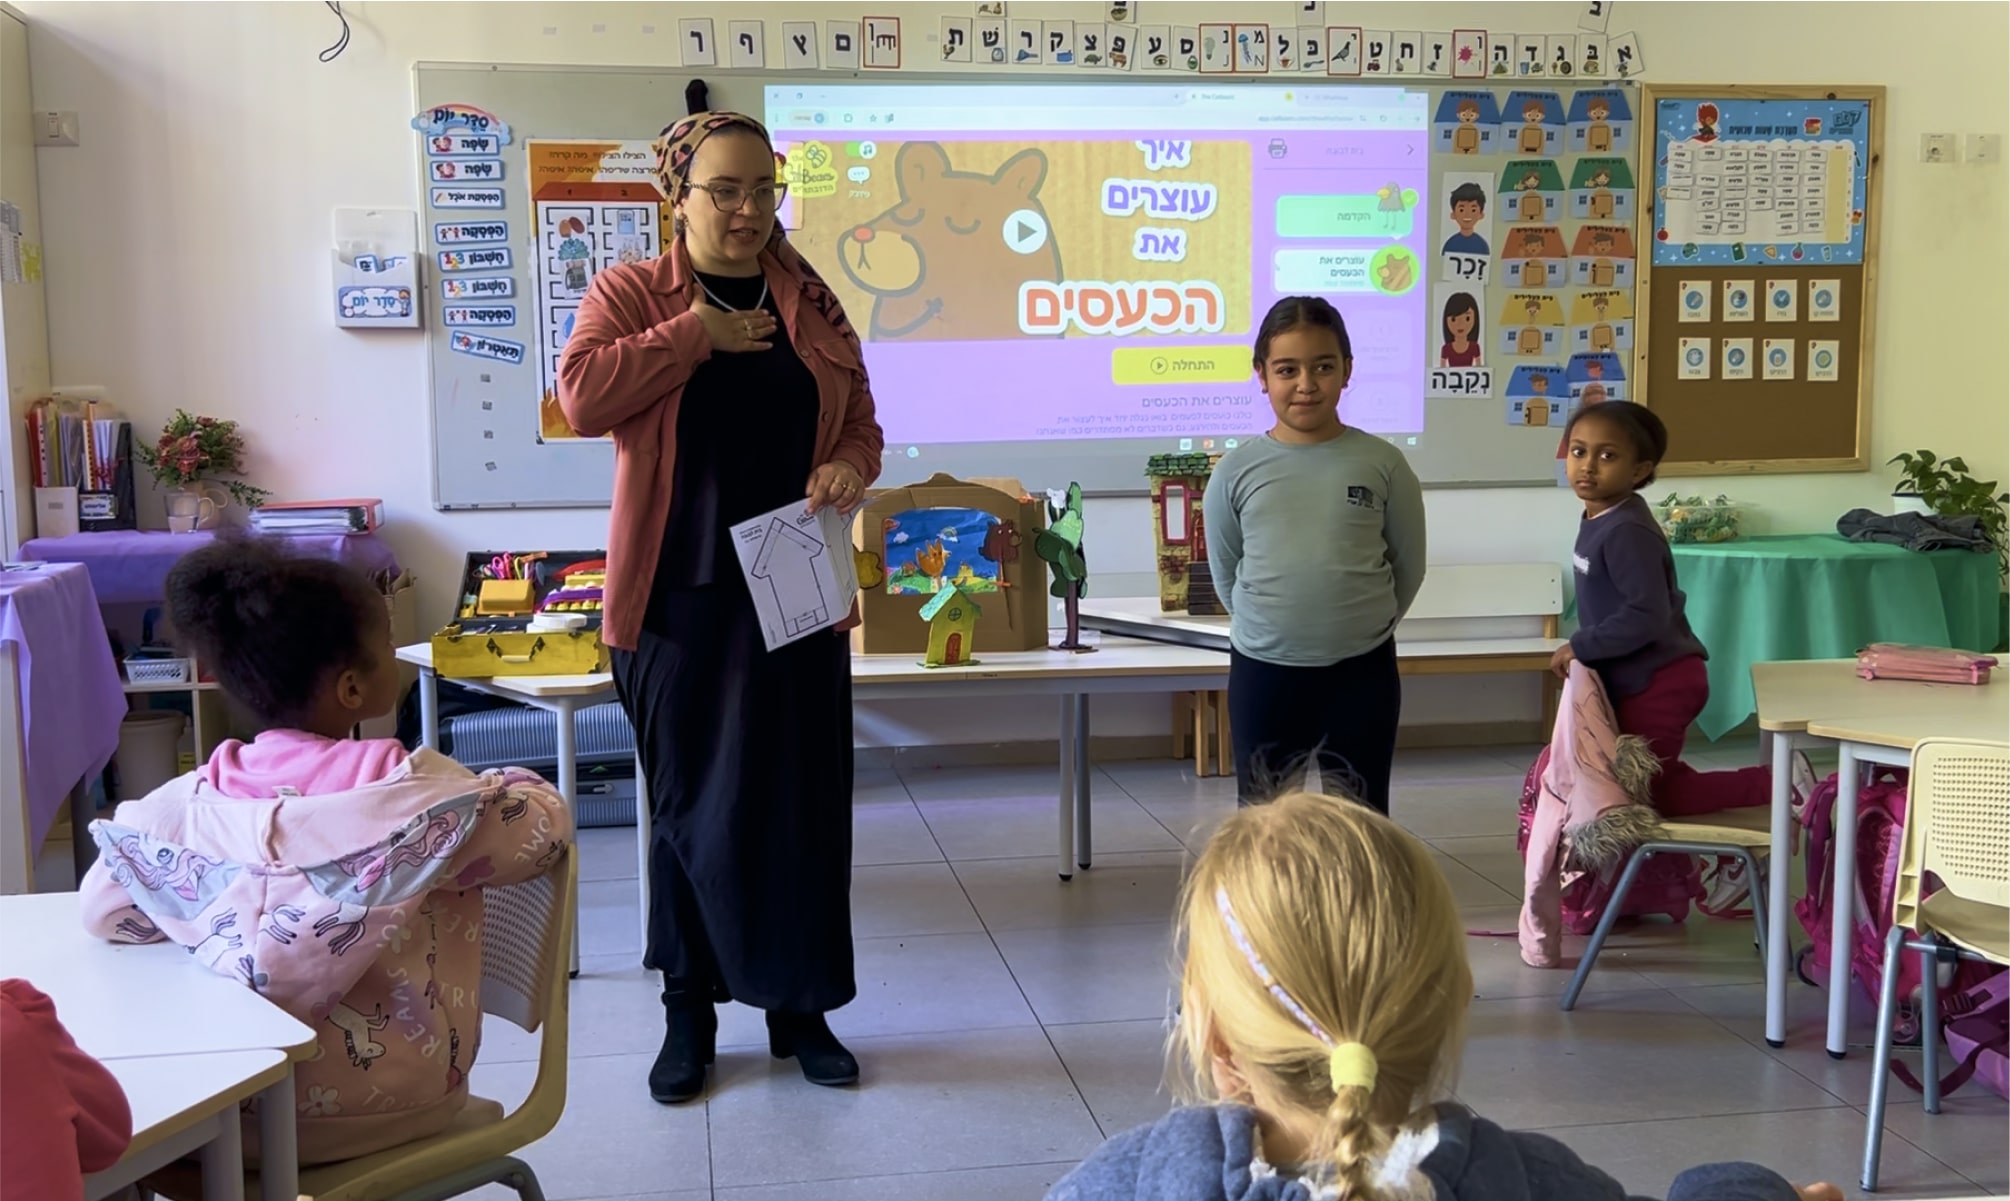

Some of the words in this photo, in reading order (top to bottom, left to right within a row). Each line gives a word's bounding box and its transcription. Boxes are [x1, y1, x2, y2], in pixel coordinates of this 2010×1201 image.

[948, 28, 964, 46] ת
[1021, 31, 1032, 48] ר
[1050, 32, 1064, 52] ק
[1084, 34, 1097, 51] צ
[1148, 36, 1161, 55] ע
[1278, 34, 1290, 55] ל
[1369, 41, 1383, 58] ט
[1400, 42, 1414, 59] ח
[1433, 44, 1443, 60] ז
[1494, 45, 1507, 61] ה
[1525, 45, 1538, 61] ד
[1617, 45, 1632, 62] א
[1142, 140, 1185, 163] איך
[1108, 184, 1211, 214] עוצרים
[1337, 212, 1371, 222] הקדמה
[1140, 233, 1181, 255] את
[1319, 257, 1333, 265] את
[1335, 257, 1365, 265] עוצרים
[1330, 269, 1365, 277] הכעסים
[1026, 288, 1218, 328] הכעסים
[1172, 359, 1215, 371] התחלה
[1142, 397, 1188, 408] הכעסים
[1191, 397, 1210, 407] את
[1213, 396, 1252, 406] עוצרים
